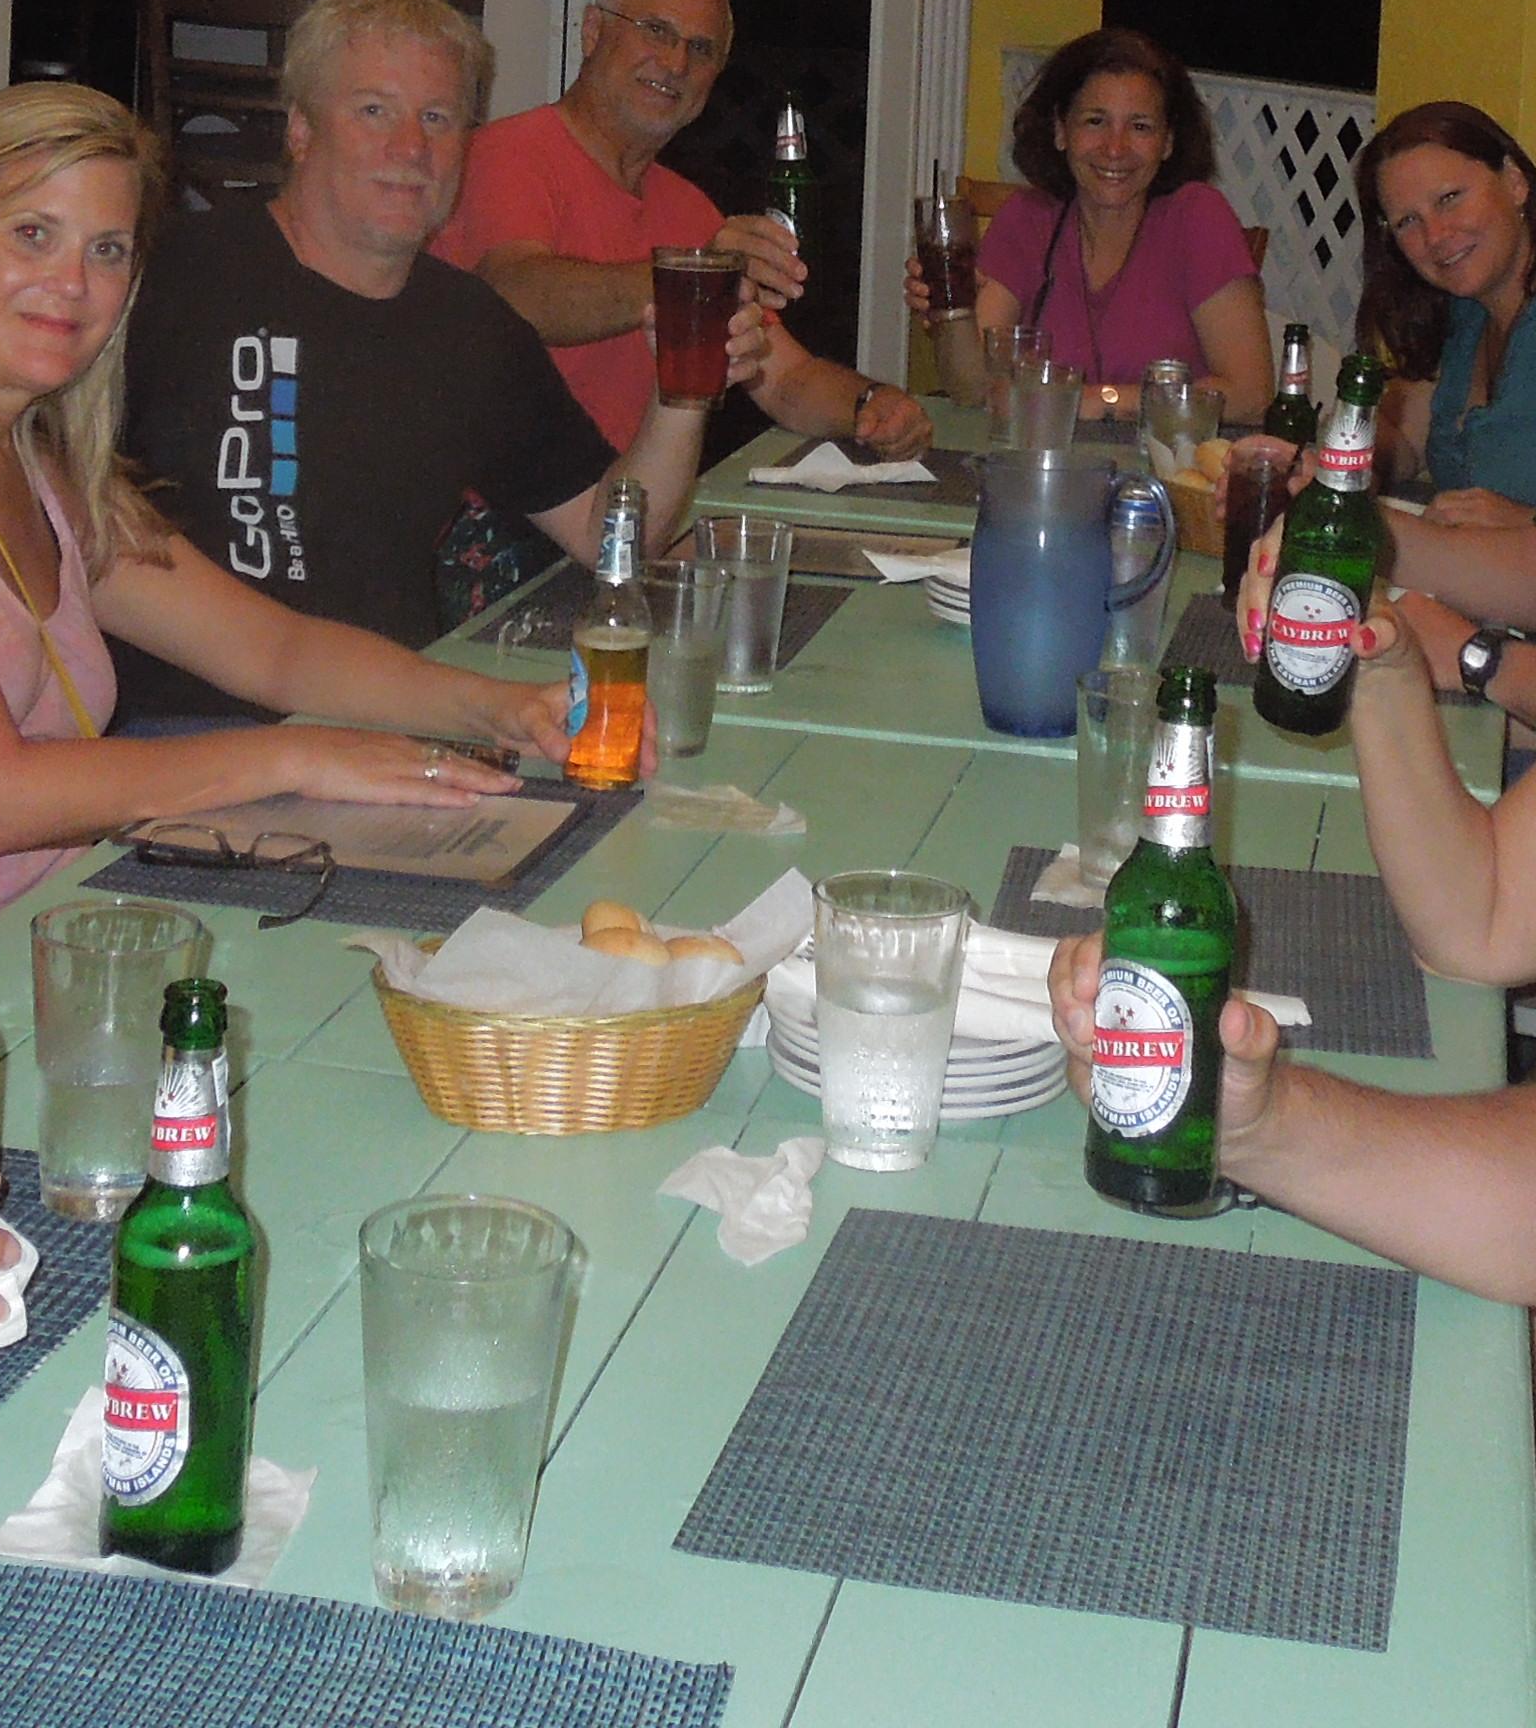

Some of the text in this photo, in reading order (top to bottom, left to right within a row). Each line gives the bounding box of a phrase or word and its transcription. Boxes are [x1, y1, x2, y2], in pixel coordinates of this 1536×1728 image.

[217, 335, 271, 579] GoPro
[1272, 620, 1348, 641] CAYBREW
[1137, 977, 1170, 1008] BEER
[1168, 1006, 1182, 1029] OF
[1095, 1100, 1137, 1126] CAYMAN
[1140, 1072, 1181, 1123] ISLANDS
[156, 1126, 212, 1142] BREW
[129, 1332, 175, 1387] BEER OF
[133, 1438, 175, 1491] ISLANDS
